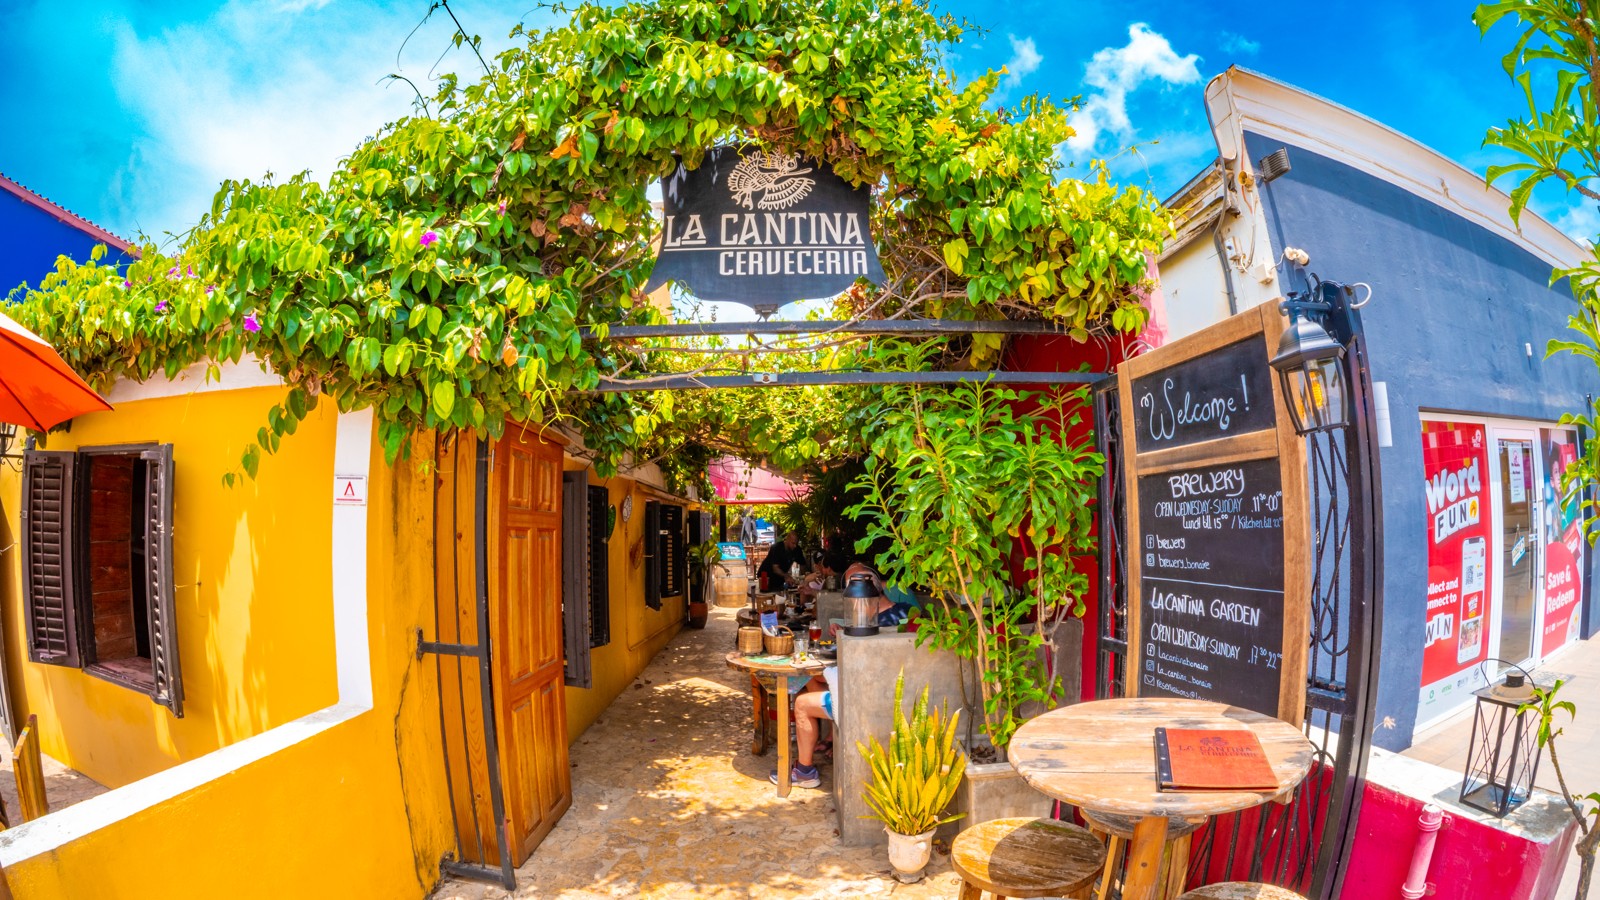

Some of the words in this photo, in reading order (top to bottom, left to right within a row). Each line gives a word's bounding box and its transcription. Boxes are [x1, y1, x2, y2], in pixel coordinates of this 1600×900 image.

[664, 214, 707, 247] LA
[720, 212, 865, 246] CANTINA
[719, 250, 868, 276] CERVECERIA
[1426, 457, 1480, 514] Word
[1154, 501, 1172, 518] OPEN
[1438, 502, 1467, 538] FUN
[1156, 534, 1186, 549] brewery
[1446, 577, 1458, 590] and
[1548, 570, 1565, 590] Save
[1566, 565, 1572, 583] &
[1450, 592, 1457, 604] to
[1546, 588, 1575, 615] Redeem
[1210, 599, 1260, 627] GARDEN
[1150, 623, 1170, 643] OPEN
[1425, 617, 1451, 644] WIN
